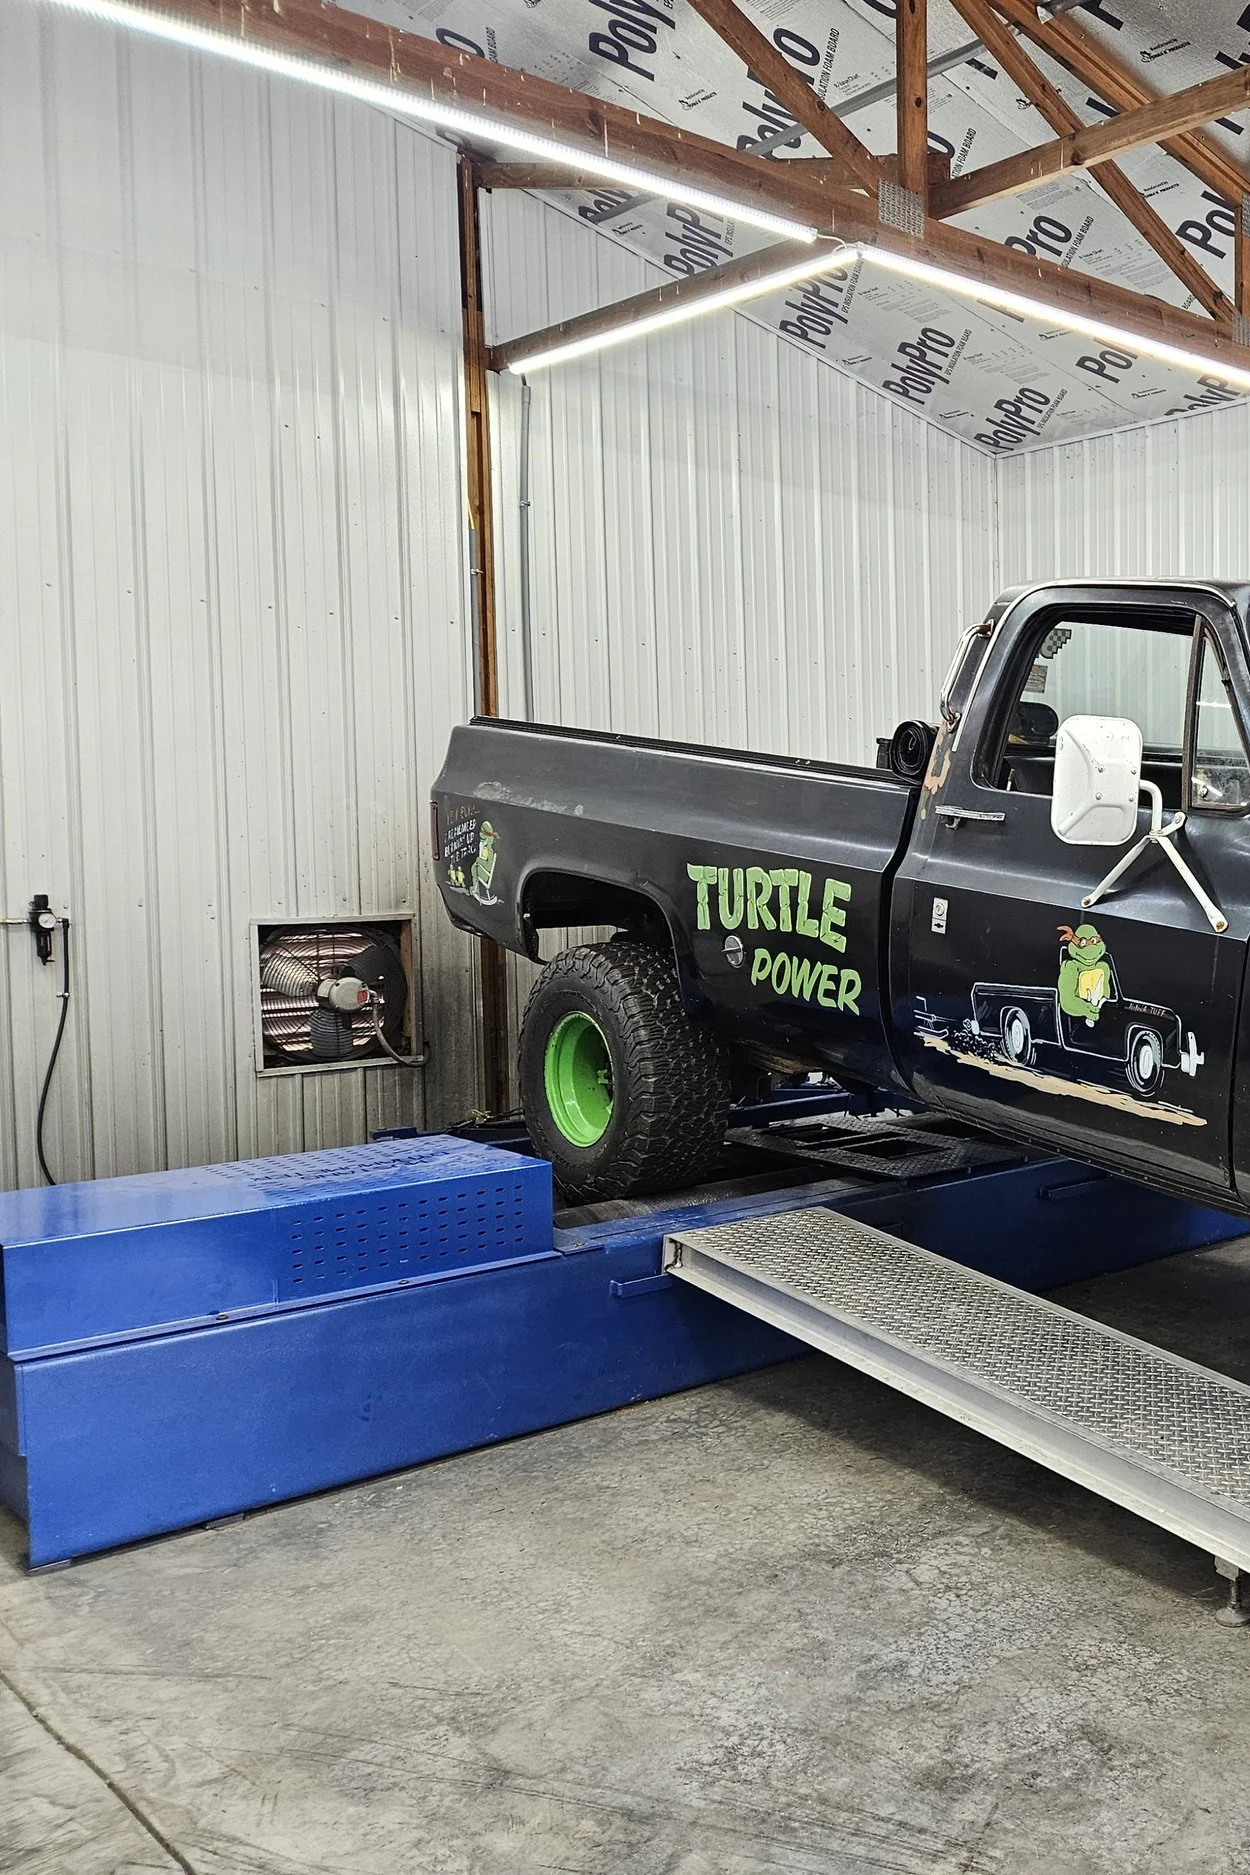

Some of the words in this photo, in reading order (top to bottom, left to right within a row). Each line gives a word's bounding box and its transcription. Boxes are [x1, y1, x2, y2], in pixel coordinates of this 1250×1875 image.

[588, 0, 676, 82] Poly
[823, 51, 834, 72] FOAM
[828, 28, 839, 53] BOARD
[963, 128, 977, 151] BOARD
[1073, 233, 1085, 250] FOAM
[1080, 215, 1094, 235] BOARD
[779, 267, 848, 349] PolyPro
[882, 327, 955, 405] PolyPro
[974, 387, 1051, 450] PolyPro
[686, 863, 853, 954] TURTLE
[751, 947, 863, 1016] POWER
